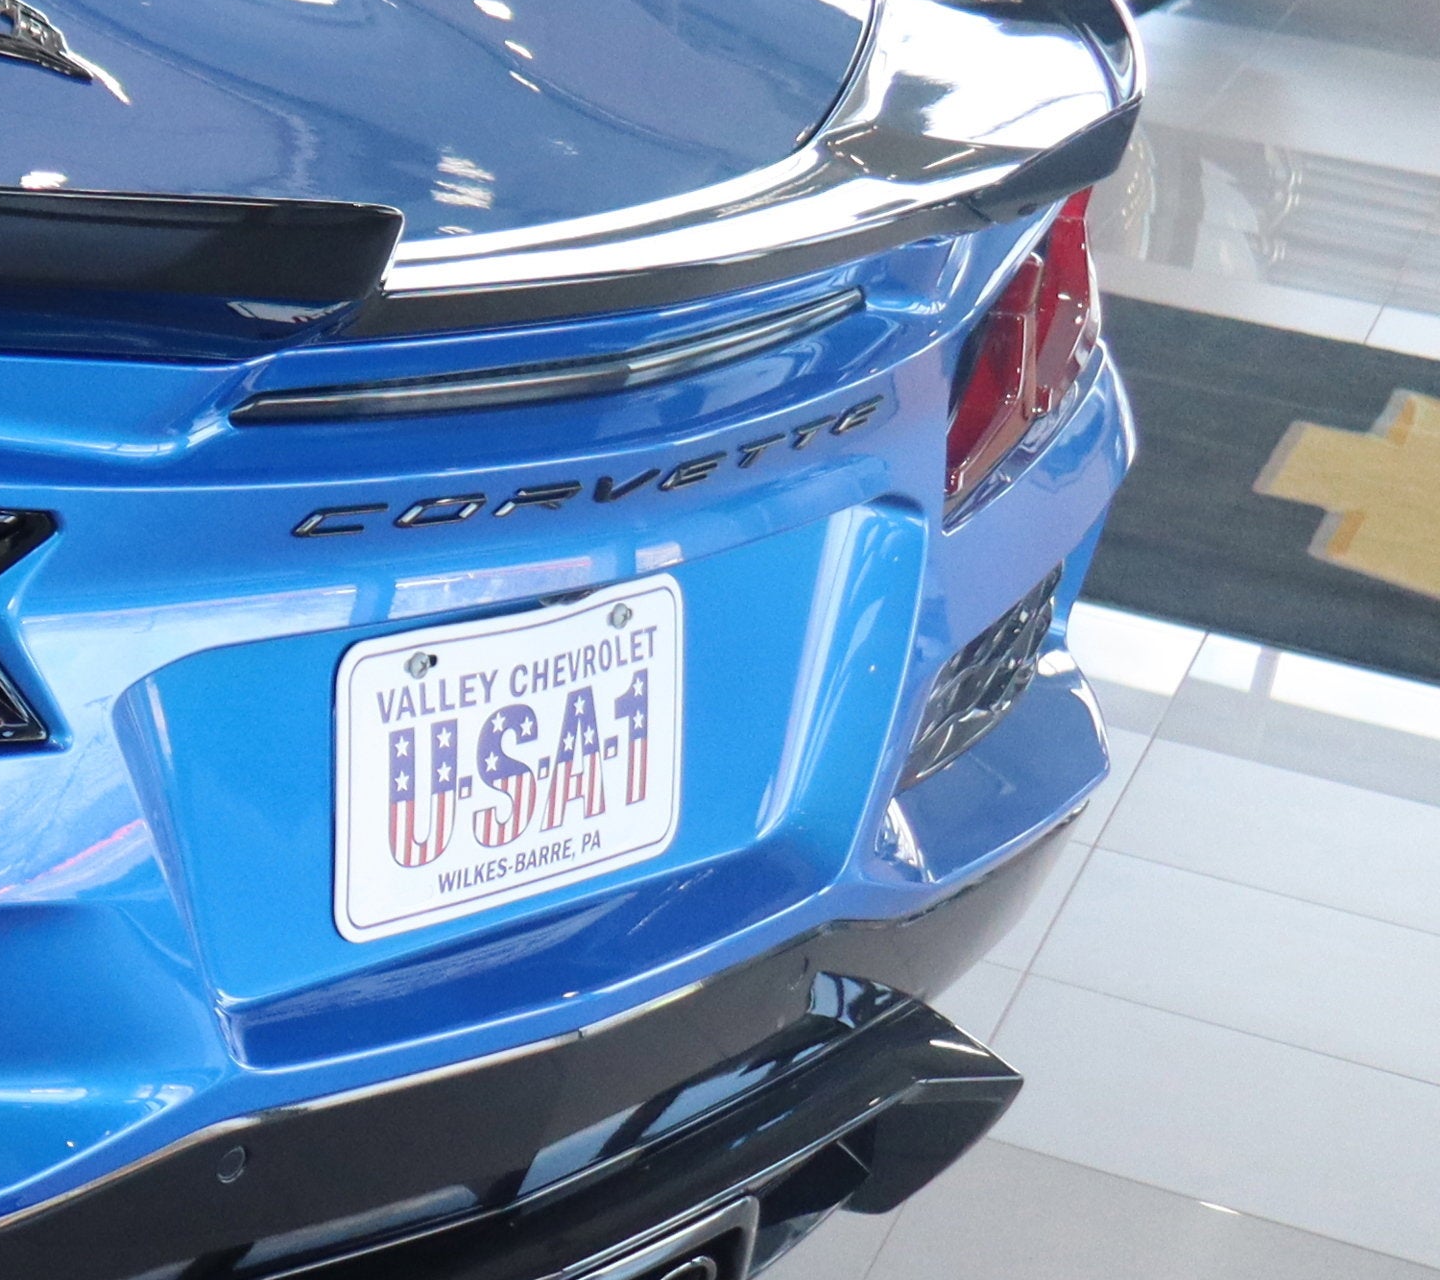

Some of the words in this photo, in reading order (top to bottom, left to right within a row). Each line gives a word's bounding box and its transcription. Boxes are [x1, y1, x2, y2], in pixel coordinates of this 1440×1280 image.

[291, 395, 884, 537] CORVETTE
[377, 669, 499, 724] VALLEY
[509, 625, 658, 698] CHEVROLET
[438, 836, 577, 894] WILKES-BARRE,
[580, 829, 602, 854] PA
